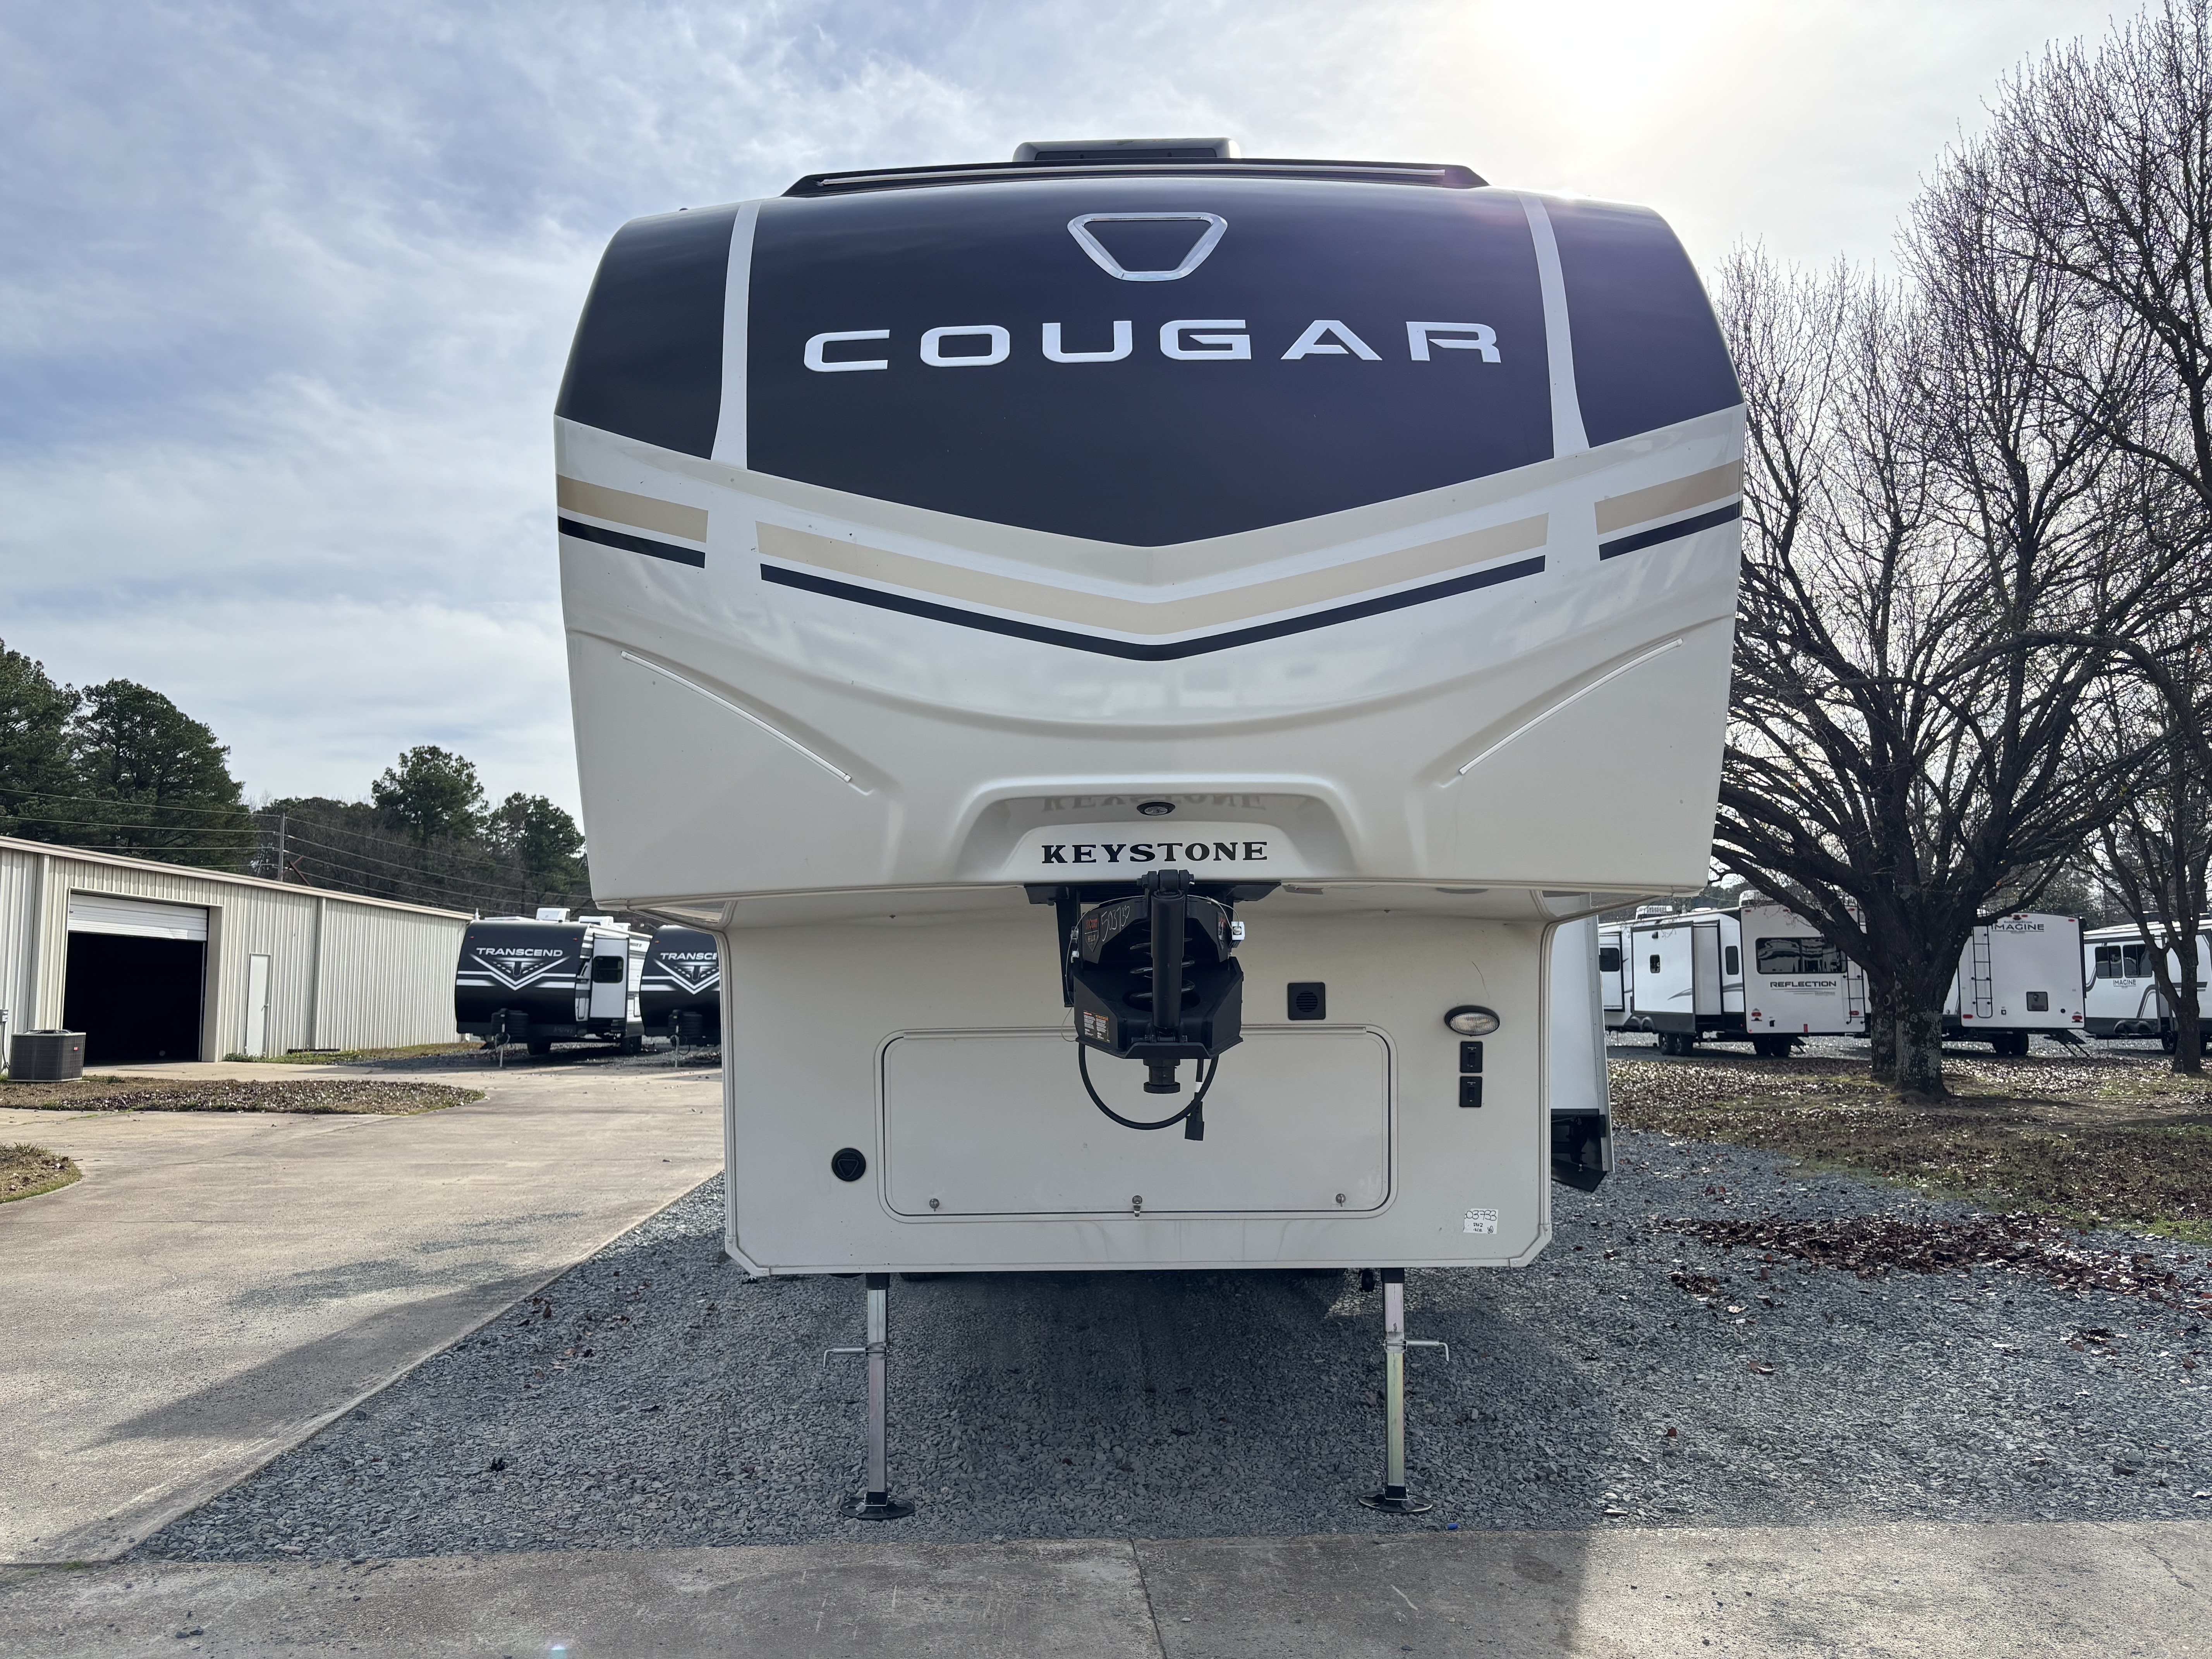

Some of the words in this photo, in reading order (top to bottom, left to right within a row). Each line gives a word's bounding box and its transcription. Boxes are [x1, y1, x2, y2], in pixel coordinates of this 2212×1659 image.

[804, 319, 1502, 373] COUGAR
[1041, 842, 1268, 864] KEYSTONE
[476, 948, 563, 957] TRANSCEND
